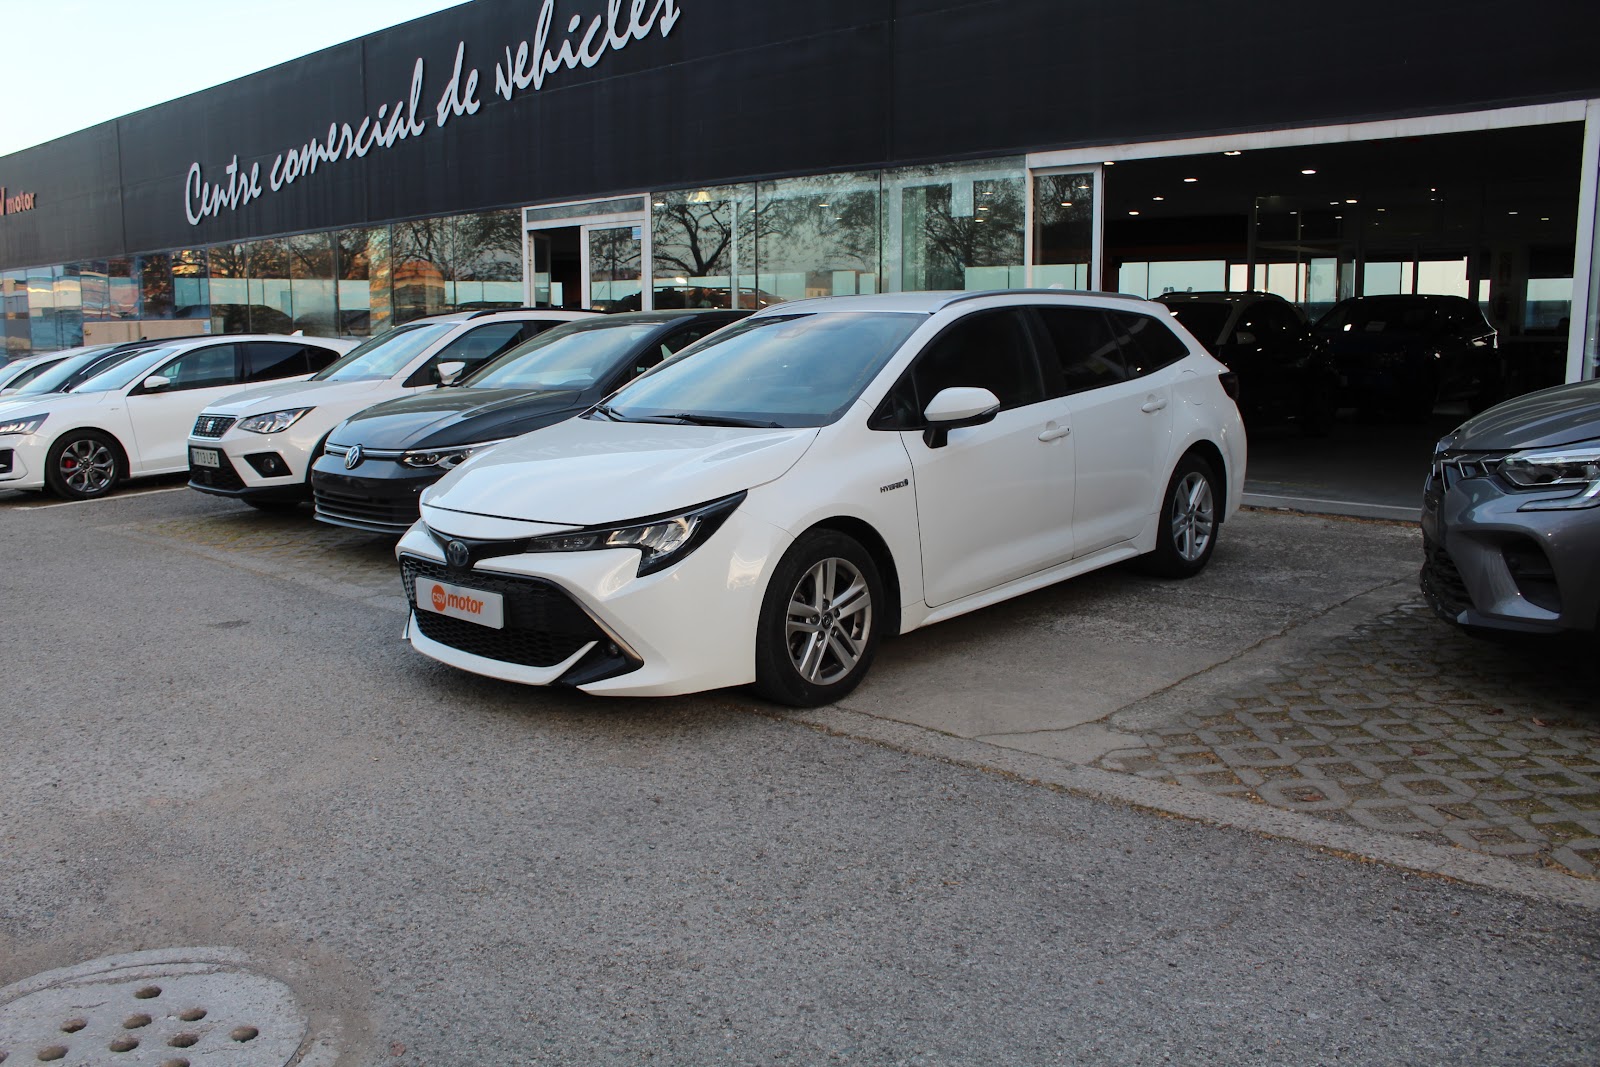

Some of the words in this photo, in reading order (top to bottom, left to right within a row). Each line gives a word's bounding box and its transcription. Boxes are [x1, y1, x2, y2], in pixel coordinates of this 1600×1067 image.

[185, 154, 262, 226] Centre
[270, 57, 425, 192] comercial
[436, 40, 481, 128] de
[495, 0, 681, 101] vehicles
[6, 190, 36, 215] motor
[447, 593, 484, 615] motor
